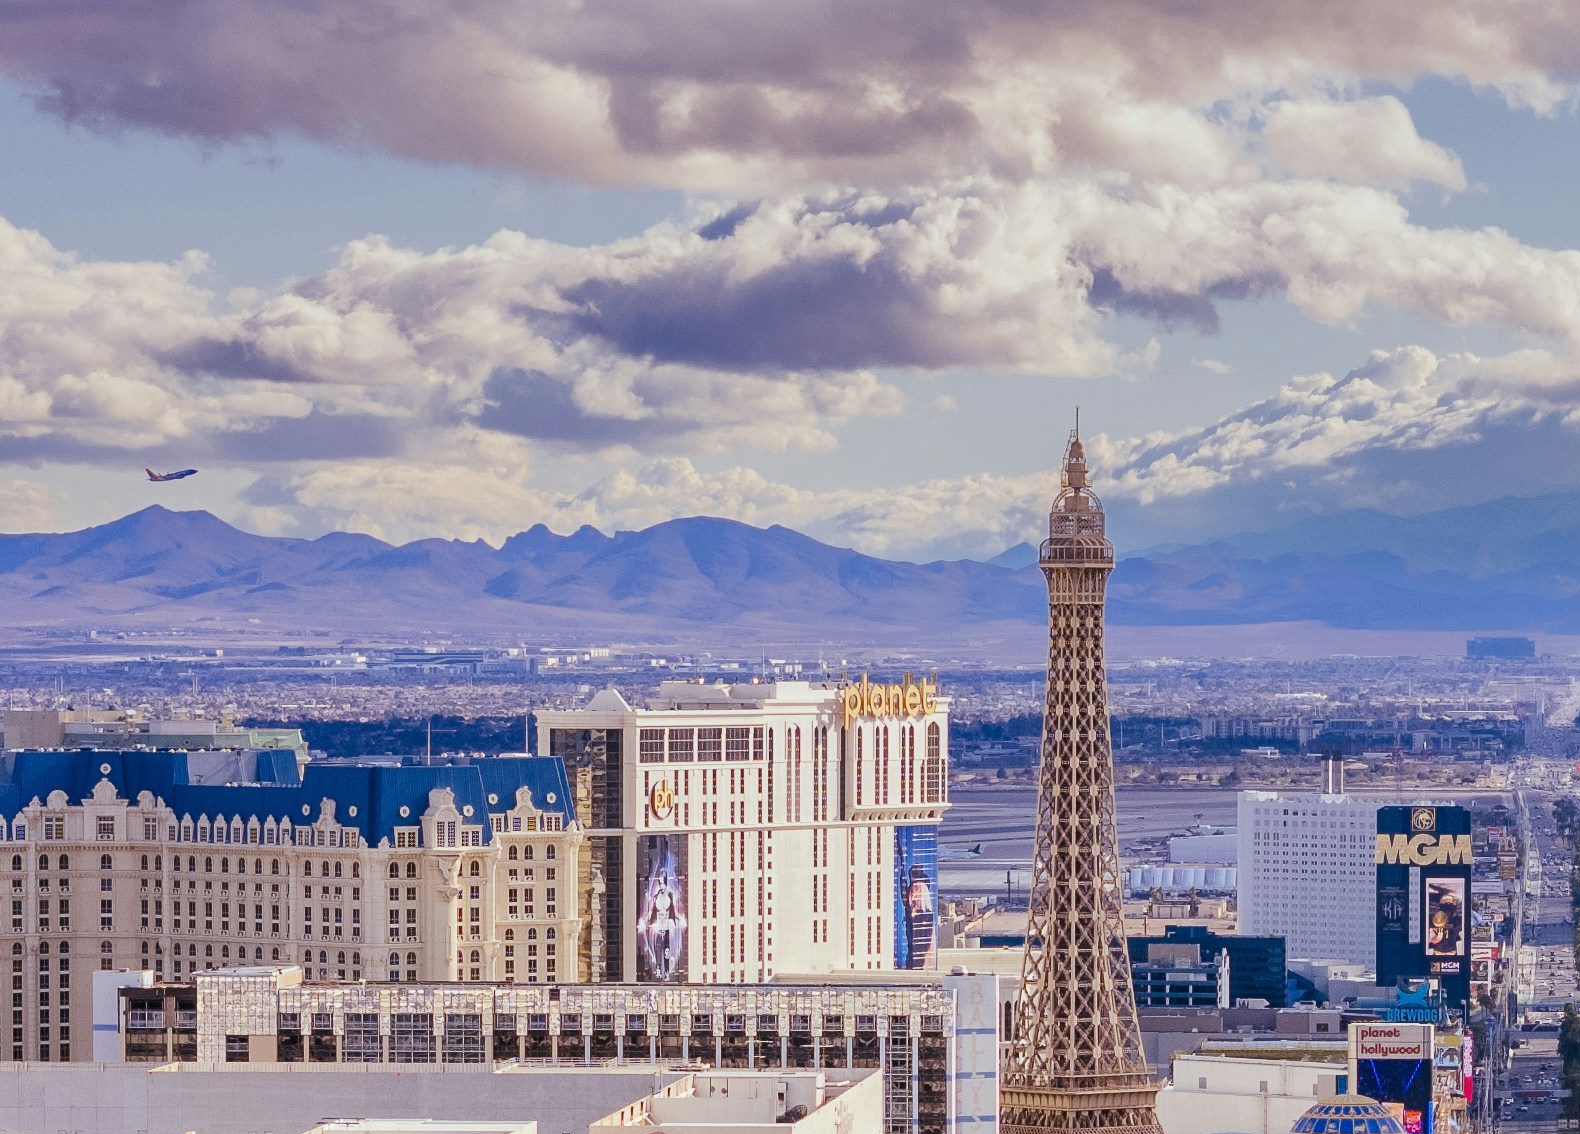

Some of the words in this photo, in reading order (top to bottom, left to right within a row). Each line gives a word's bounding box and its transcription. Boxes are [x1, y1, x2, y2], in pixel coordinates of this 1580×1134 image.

[844, 672, 937, 731] planet
[1374, 833, 1475, 865] MGM
[1387, 1008, 1438, 1022] BREWDOG
[1361, 1026, 1400, 1040] planet
[1361, 1044, 1420, 1056] hollywood
